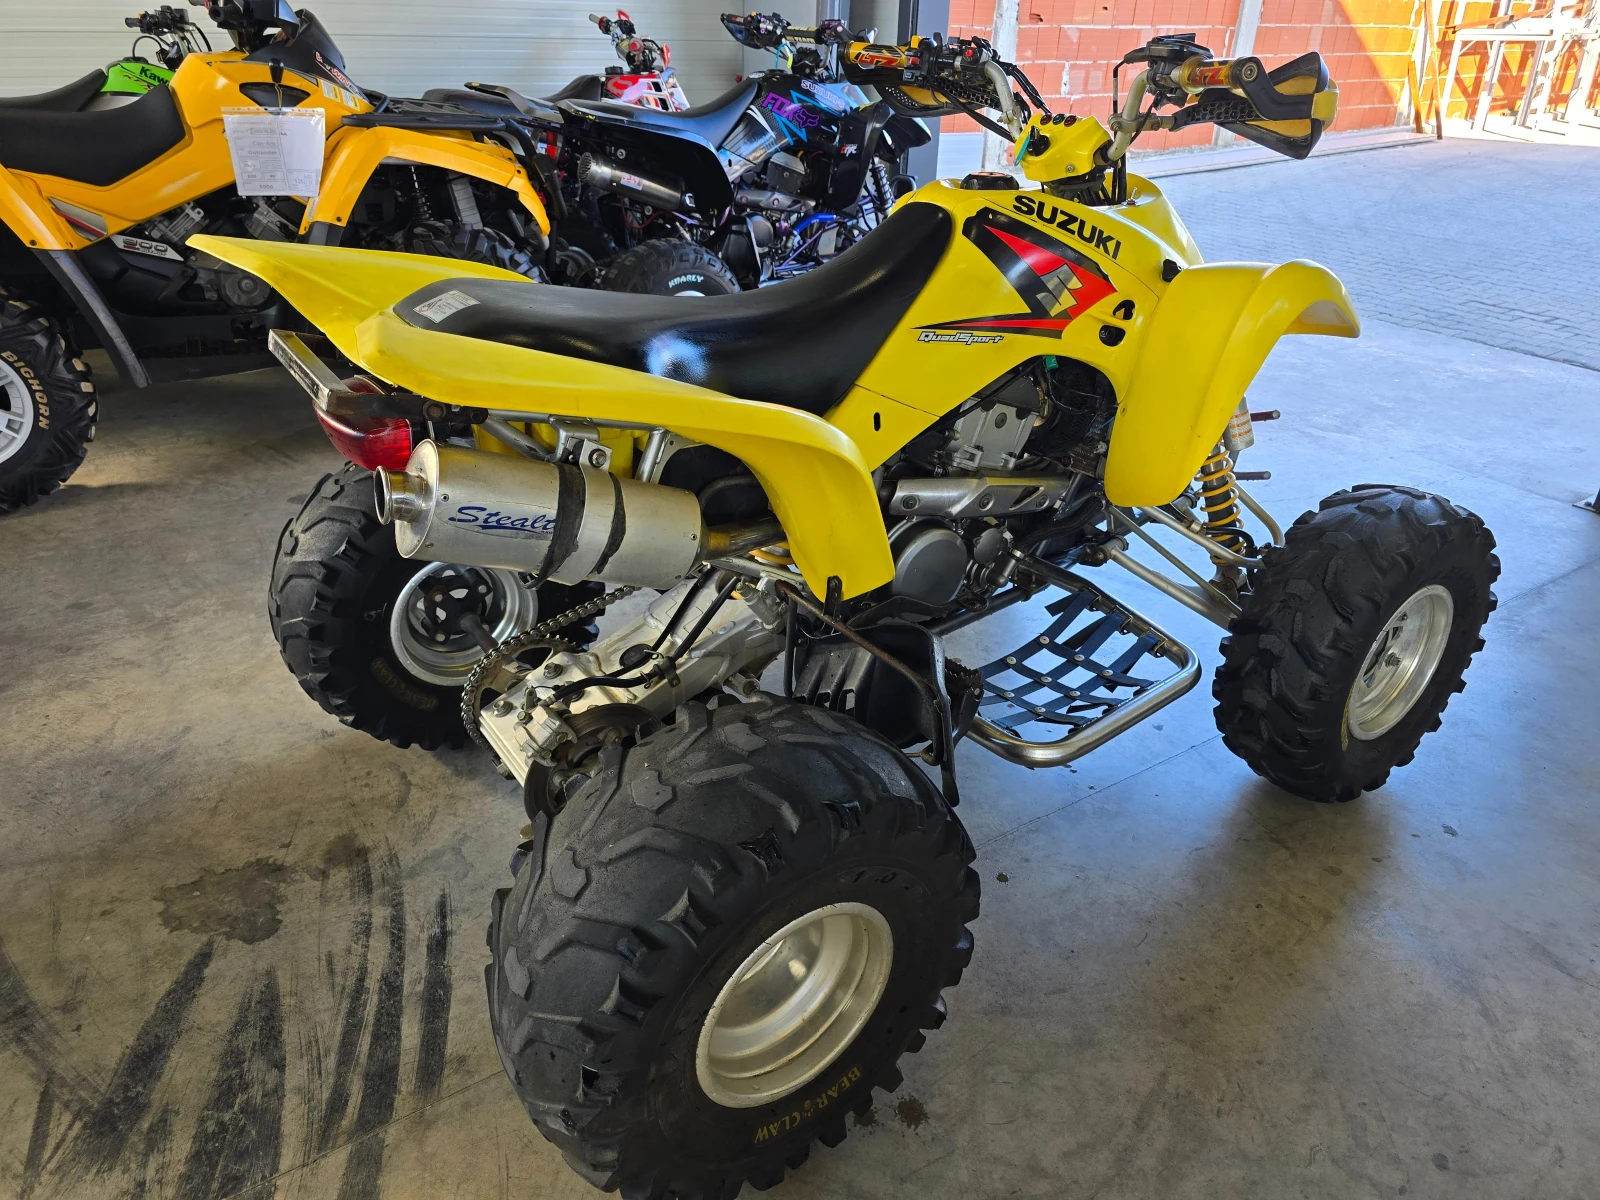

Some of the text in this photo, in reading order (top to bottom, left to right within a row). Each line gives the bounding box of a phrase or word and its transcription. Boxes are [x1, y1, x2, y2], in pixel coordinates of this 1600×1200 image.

[761, 92, 801, 121] FOX
[1013, 195, 1121, 260] SUZUKI
[917, 330, 1004, 345] QuadSport
[1, 351, 50, 430] BIGHORN
[754, 1067, 861, 1143] BEAR CLAW
